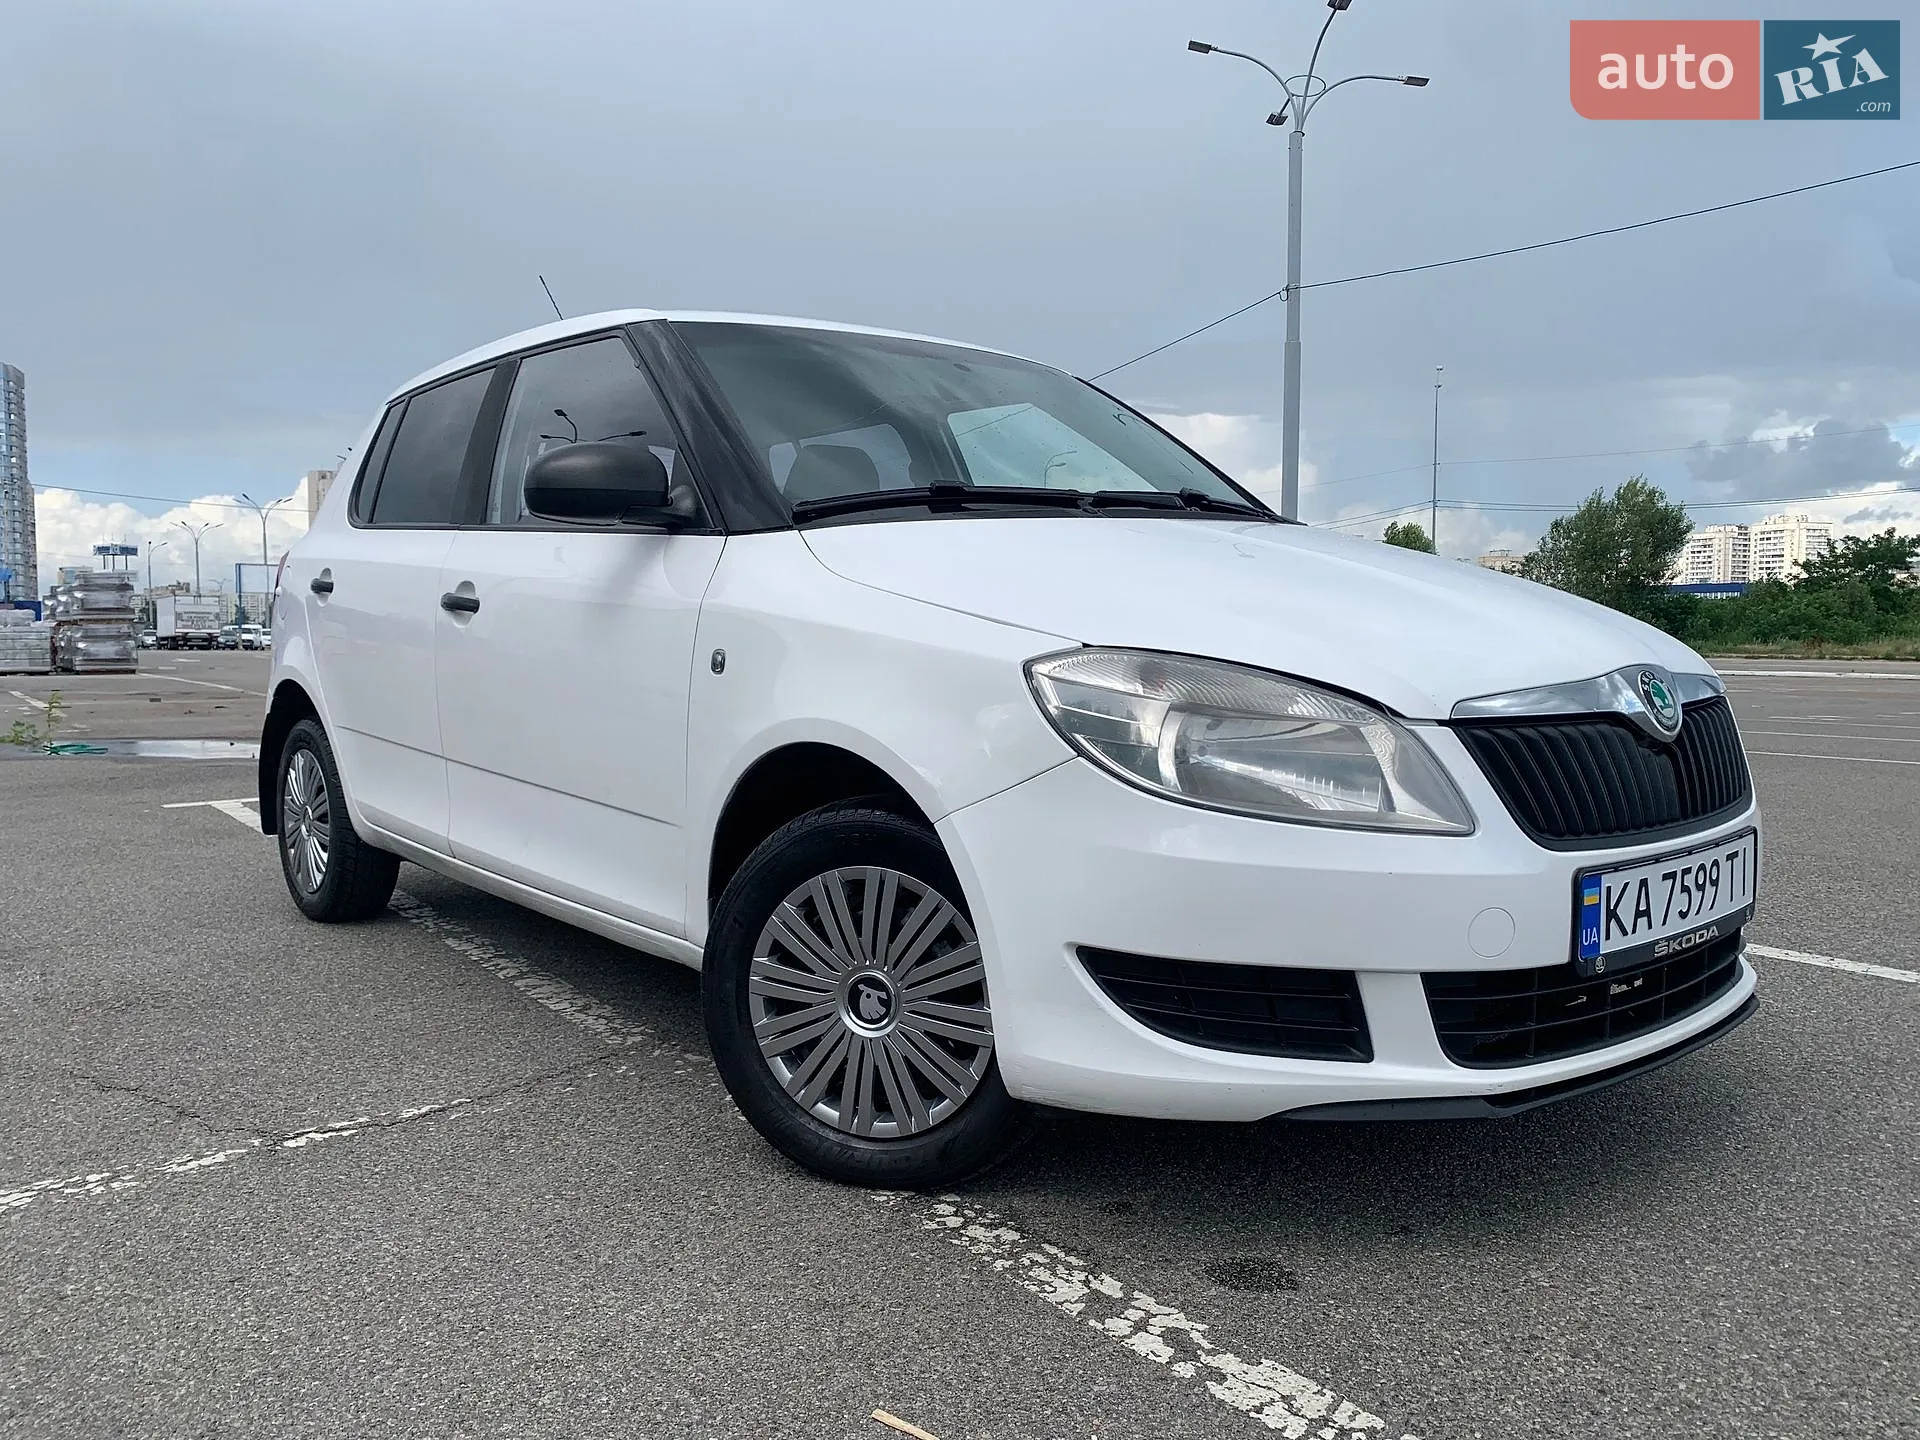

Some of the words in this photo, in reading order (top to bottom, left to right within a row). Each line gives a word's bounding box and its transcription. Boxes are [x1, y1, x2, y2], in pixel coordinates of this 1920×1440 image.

[1604, 877, 1653, 941] KA
[1661, 858, 1720, 927] 7599
[1725, 847, 1747, 903] TI
[1582, 927, 1599, 945] UA
